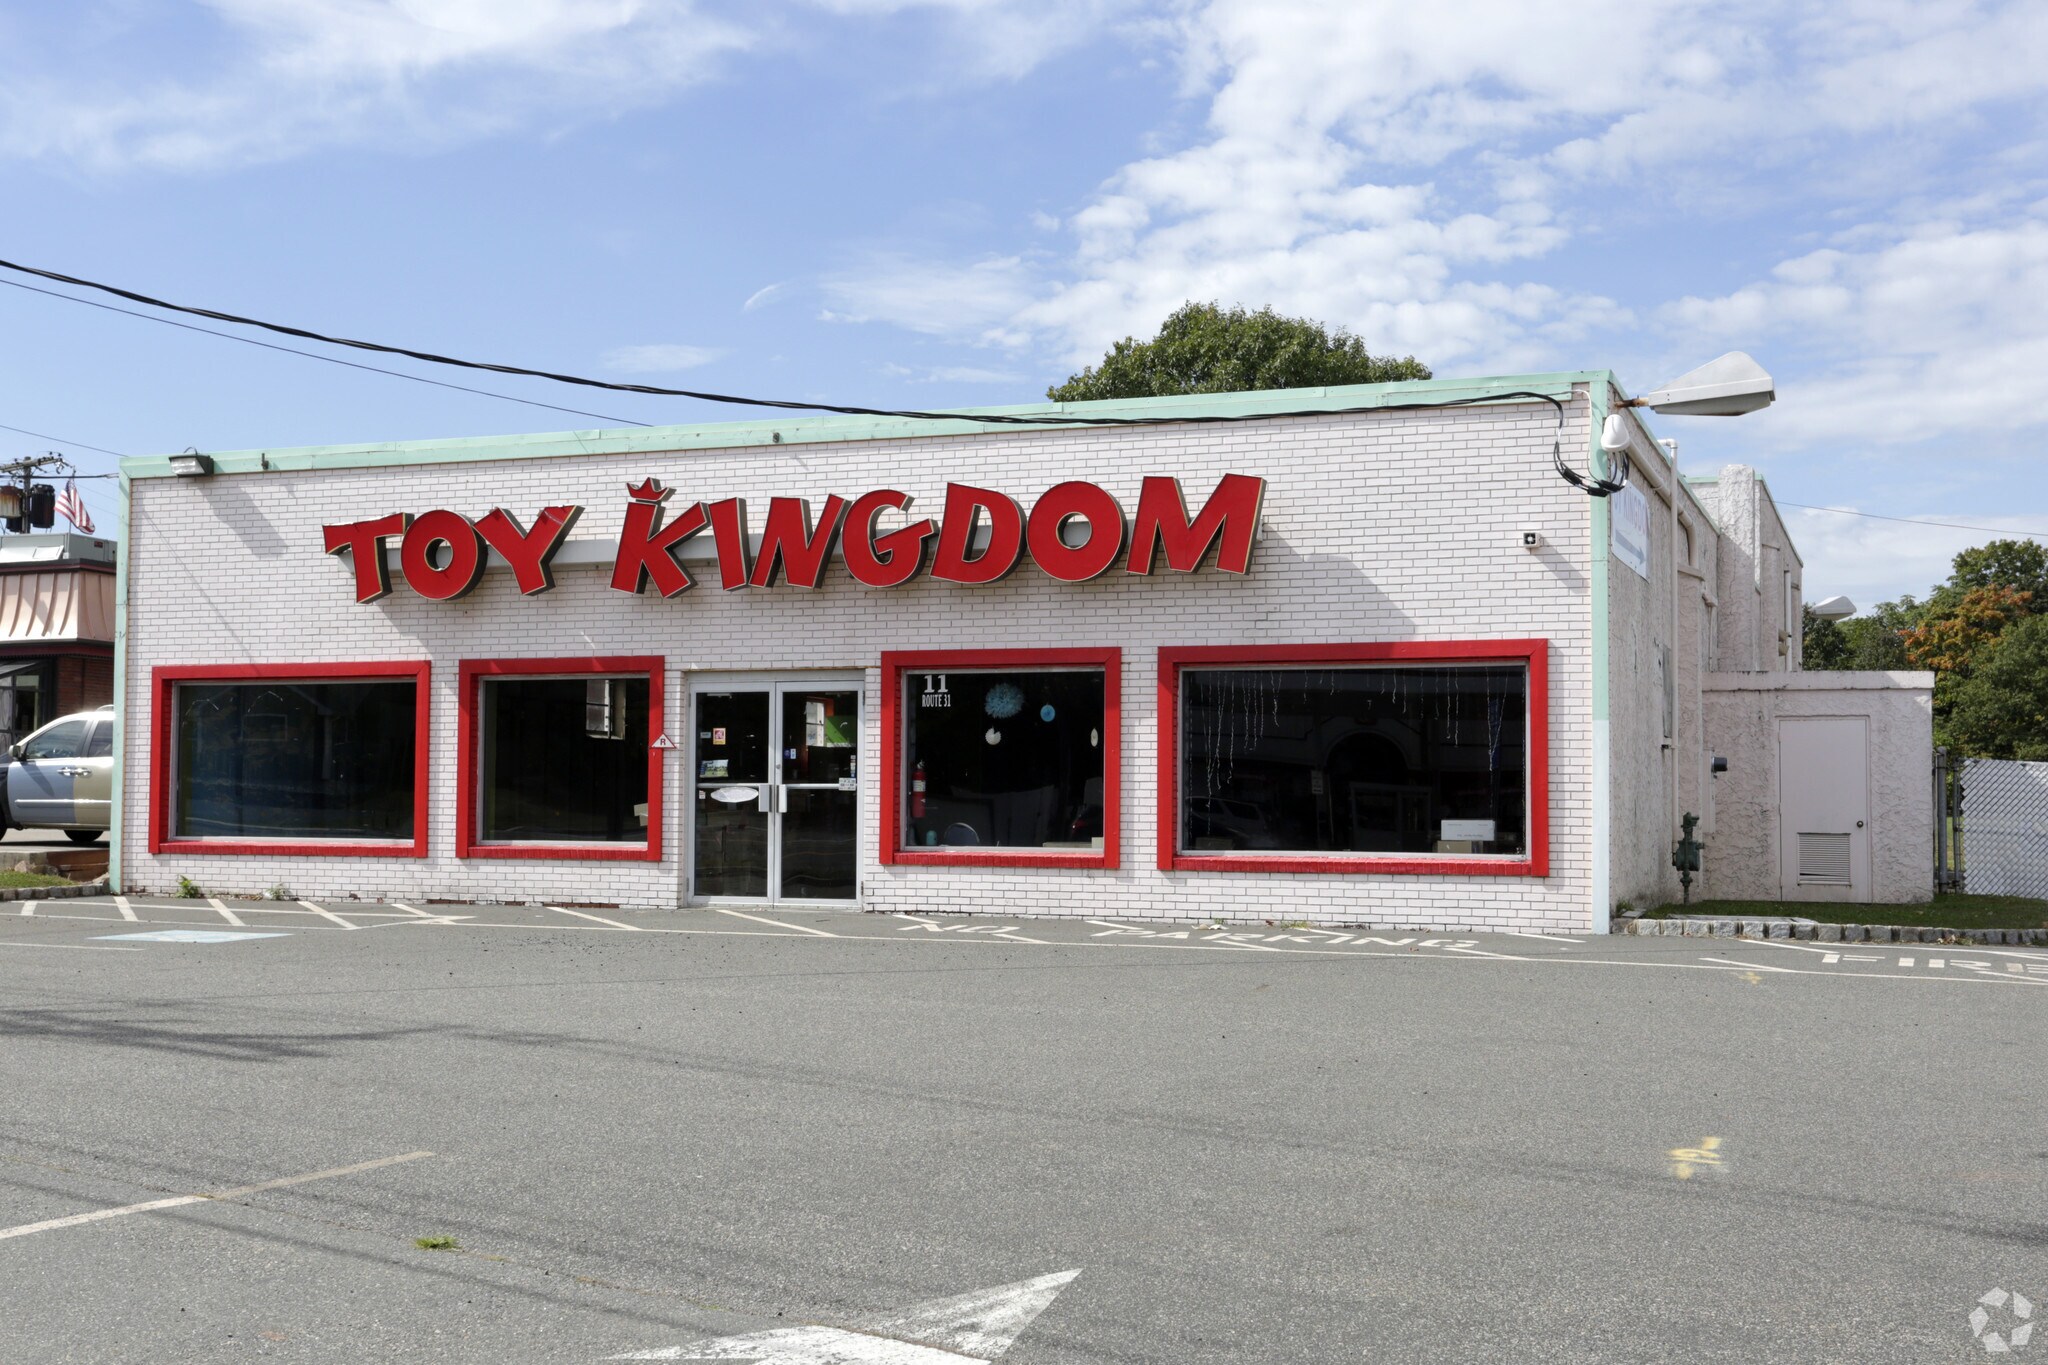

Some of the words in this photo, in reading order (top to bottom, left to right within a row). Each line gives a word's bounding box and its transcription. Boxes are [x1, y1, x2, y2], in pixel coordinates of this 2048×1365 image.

[322, 505, 585, 604] TOY
[609, 473, 1267, 599] KINGDOM
[924, 674, 949, 693] 11
[921, 694, 942, 708] ROUTE
[943, 693, 951, 708] 31
[660, 738, 666, 746] R
[897, 923, 1021, 934] NO
[1089, 929, 1480, 949] PARKING
